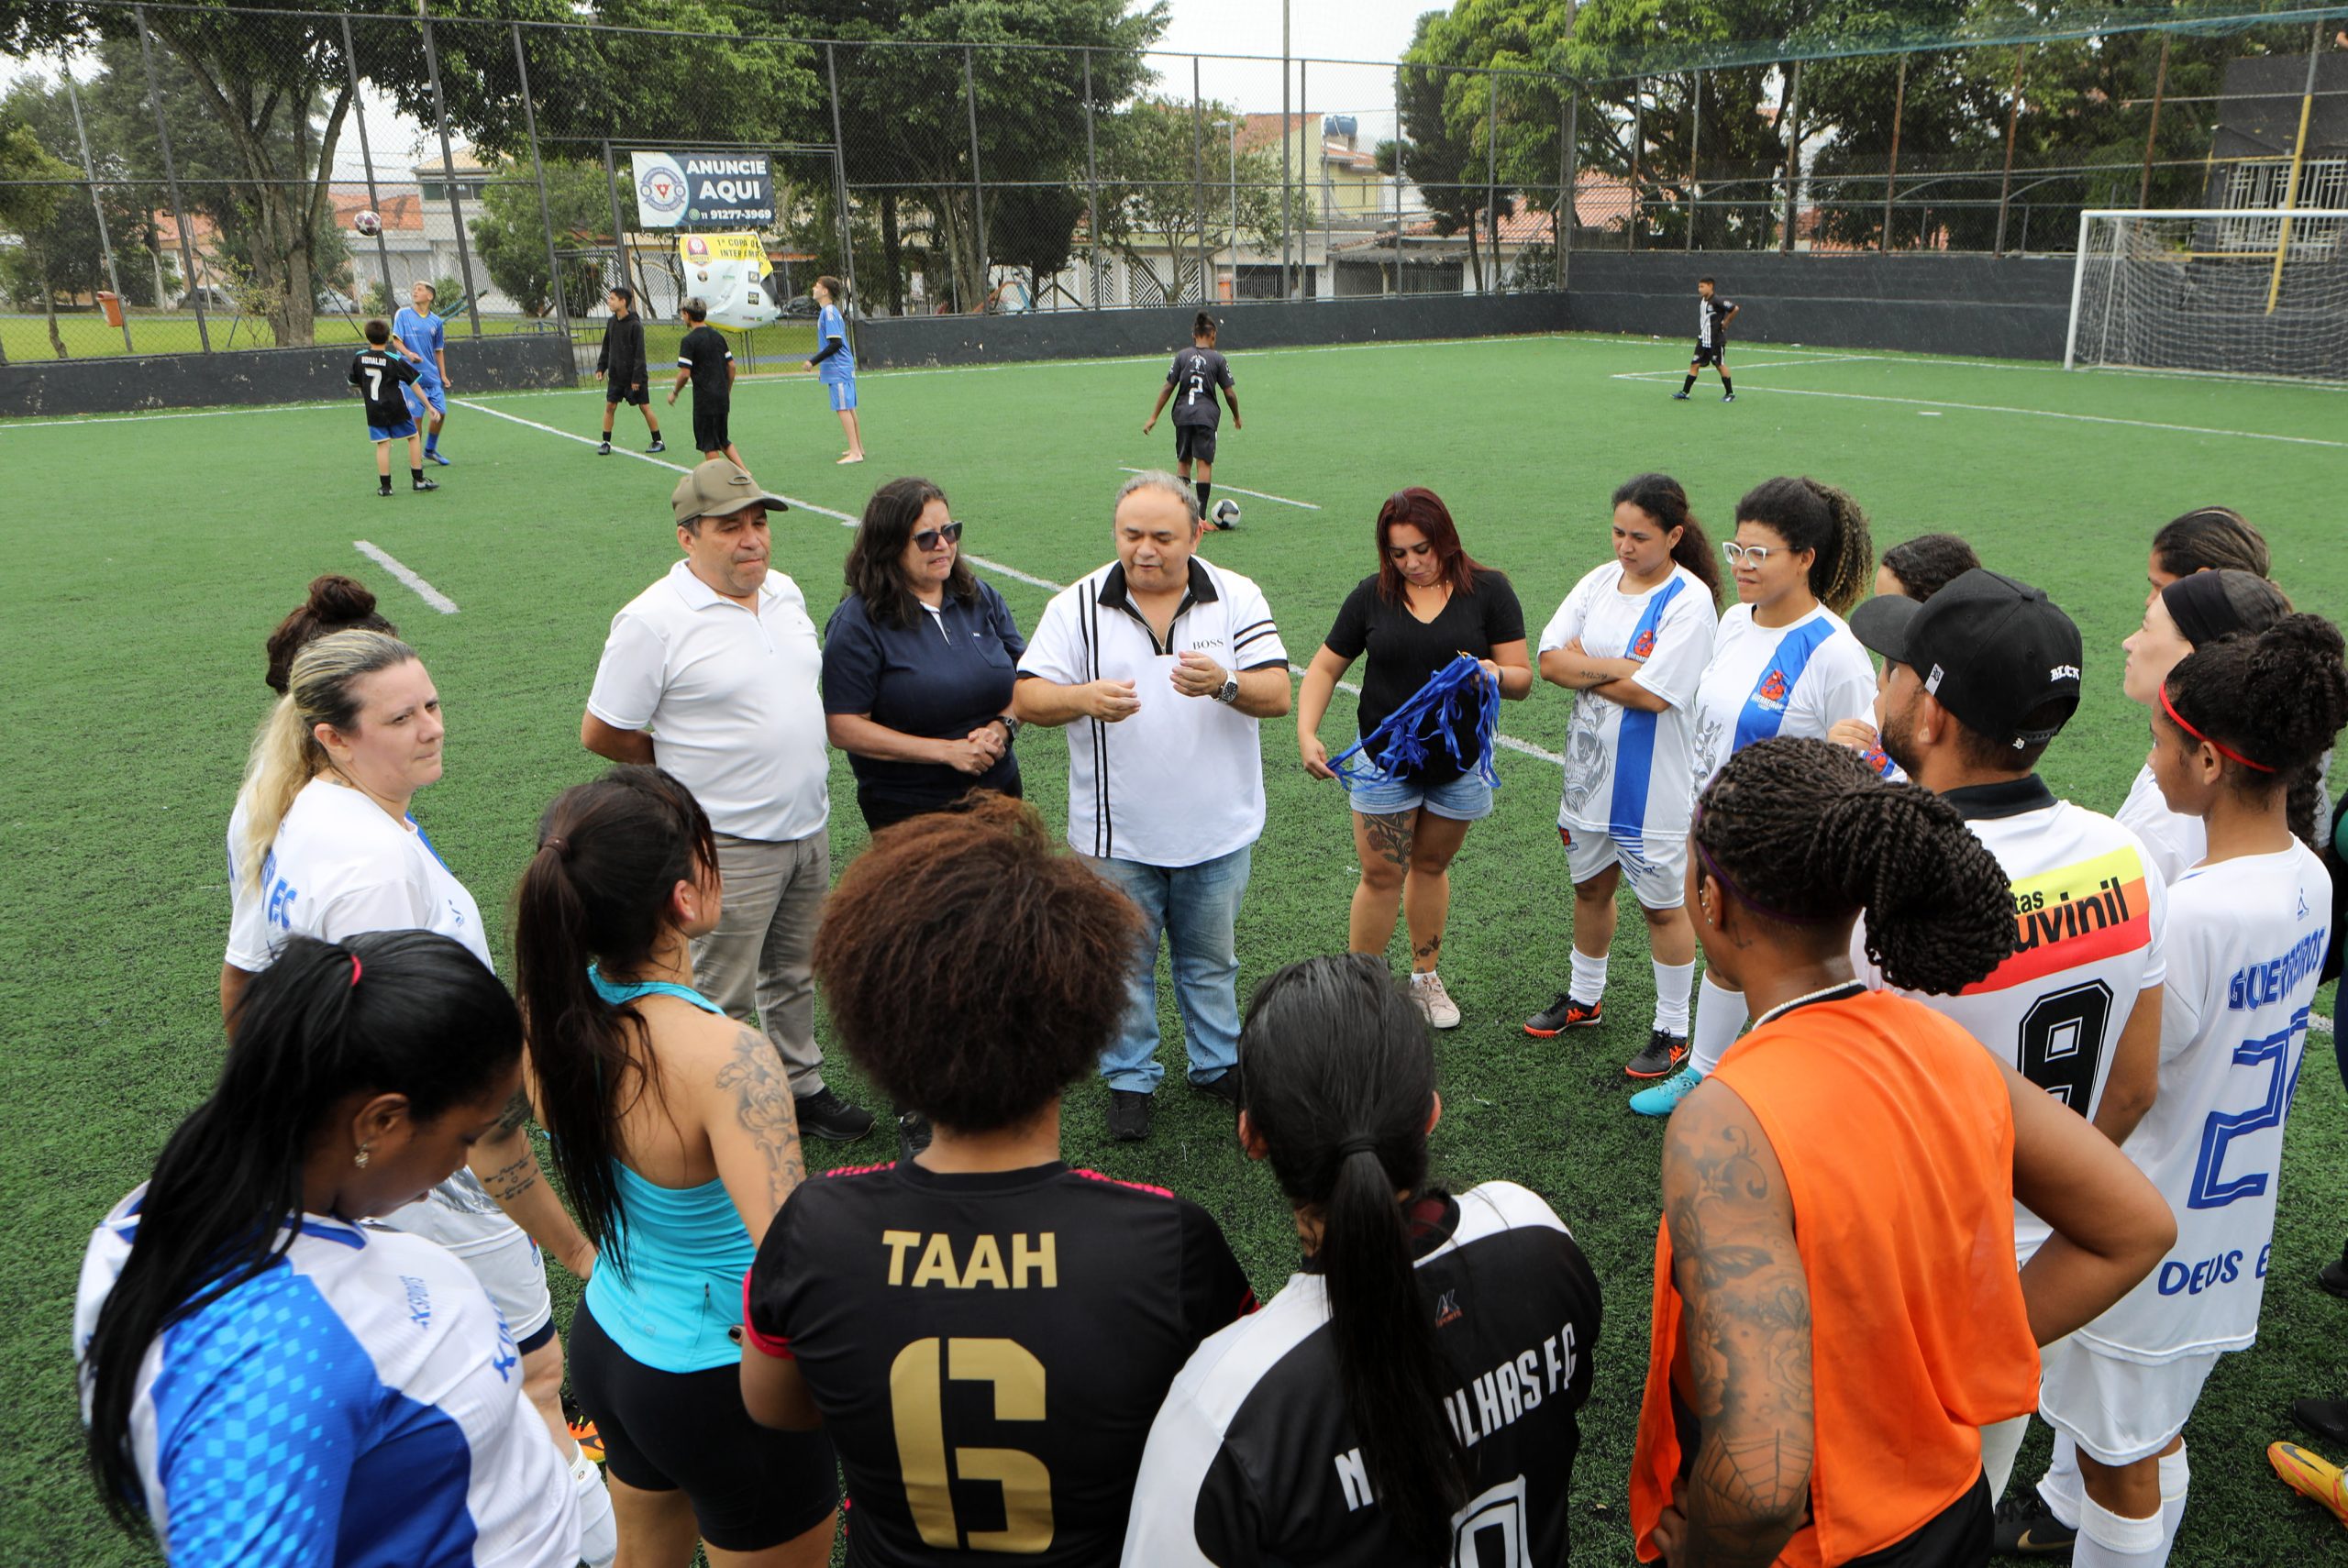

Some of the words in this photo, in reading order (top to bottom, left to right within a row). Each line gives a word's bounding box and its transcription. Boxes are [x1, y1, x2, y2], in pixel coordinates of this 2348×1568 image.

[686, 160, 767, 175] ANUNCIE
[699, 180, 761, 204] AQUI
[710, 209, 772, 219] 91277-3969
[365, 368, 382, 401] 7
[1192, 638, 1224, 650] BOSS
[2013, 890, 2043, 914] tas
[2014, 877, 2129, 953] uvinil
[2228, 925, 2326, 1012] GUERREIROS
[882, 1230, 1058, 1288] TAAH
[2158, 1249, 2243, 1296] DEUS
[890, 1337, 1055, 1553] 6
